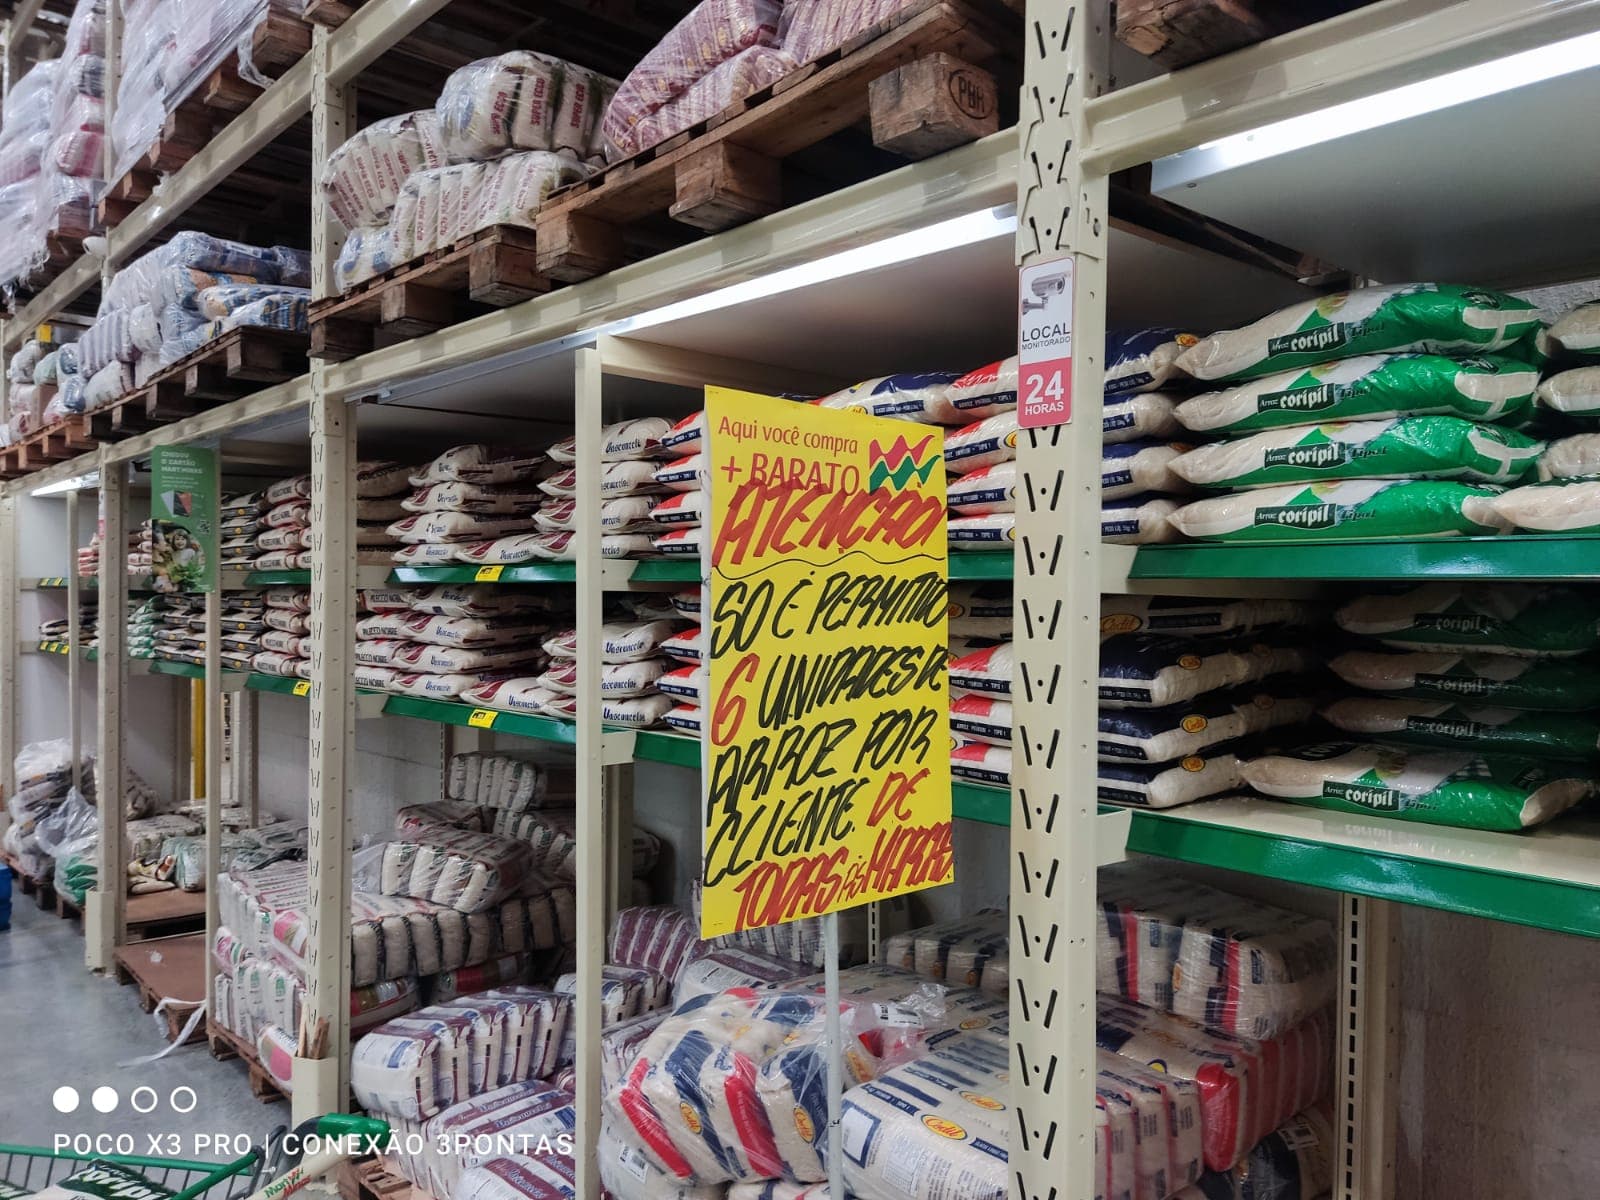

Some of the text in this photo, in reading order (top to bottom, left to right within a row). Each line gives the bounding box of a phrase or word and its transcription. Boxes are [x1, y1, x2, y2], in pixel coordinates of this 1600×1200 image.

[1021, 335, 1071, 350] MONITORADO
[1022, 322, 1071, 342] LOCAL
[1291, 323, 1339, 351] coripil
[1025, 370, 1065, 405] 24
[1280, 385, 1328, 409] coripil
[1024, 401, 1065, 416] HORAS
[718, 415, 758, 443] Aqui
[763, 425, 800, 443] você
[803, 433, 858, 457] compra
[1287, 442, 1339, 467] coripil
[720, 452, 860, 496] + BARATO
[1278, 504, 1329, 527] coripil
[1436, 615, 1481, 632] coripil
[1438, 678, 1483, 694] coripil
[711, 653, 761, 747] 6
[853, 705, 938, 774] POR
[866, 767, 931, 828] DE
[1345, 788, 1393, 808] coripil
[733, 846, 849, 931] TODAS
